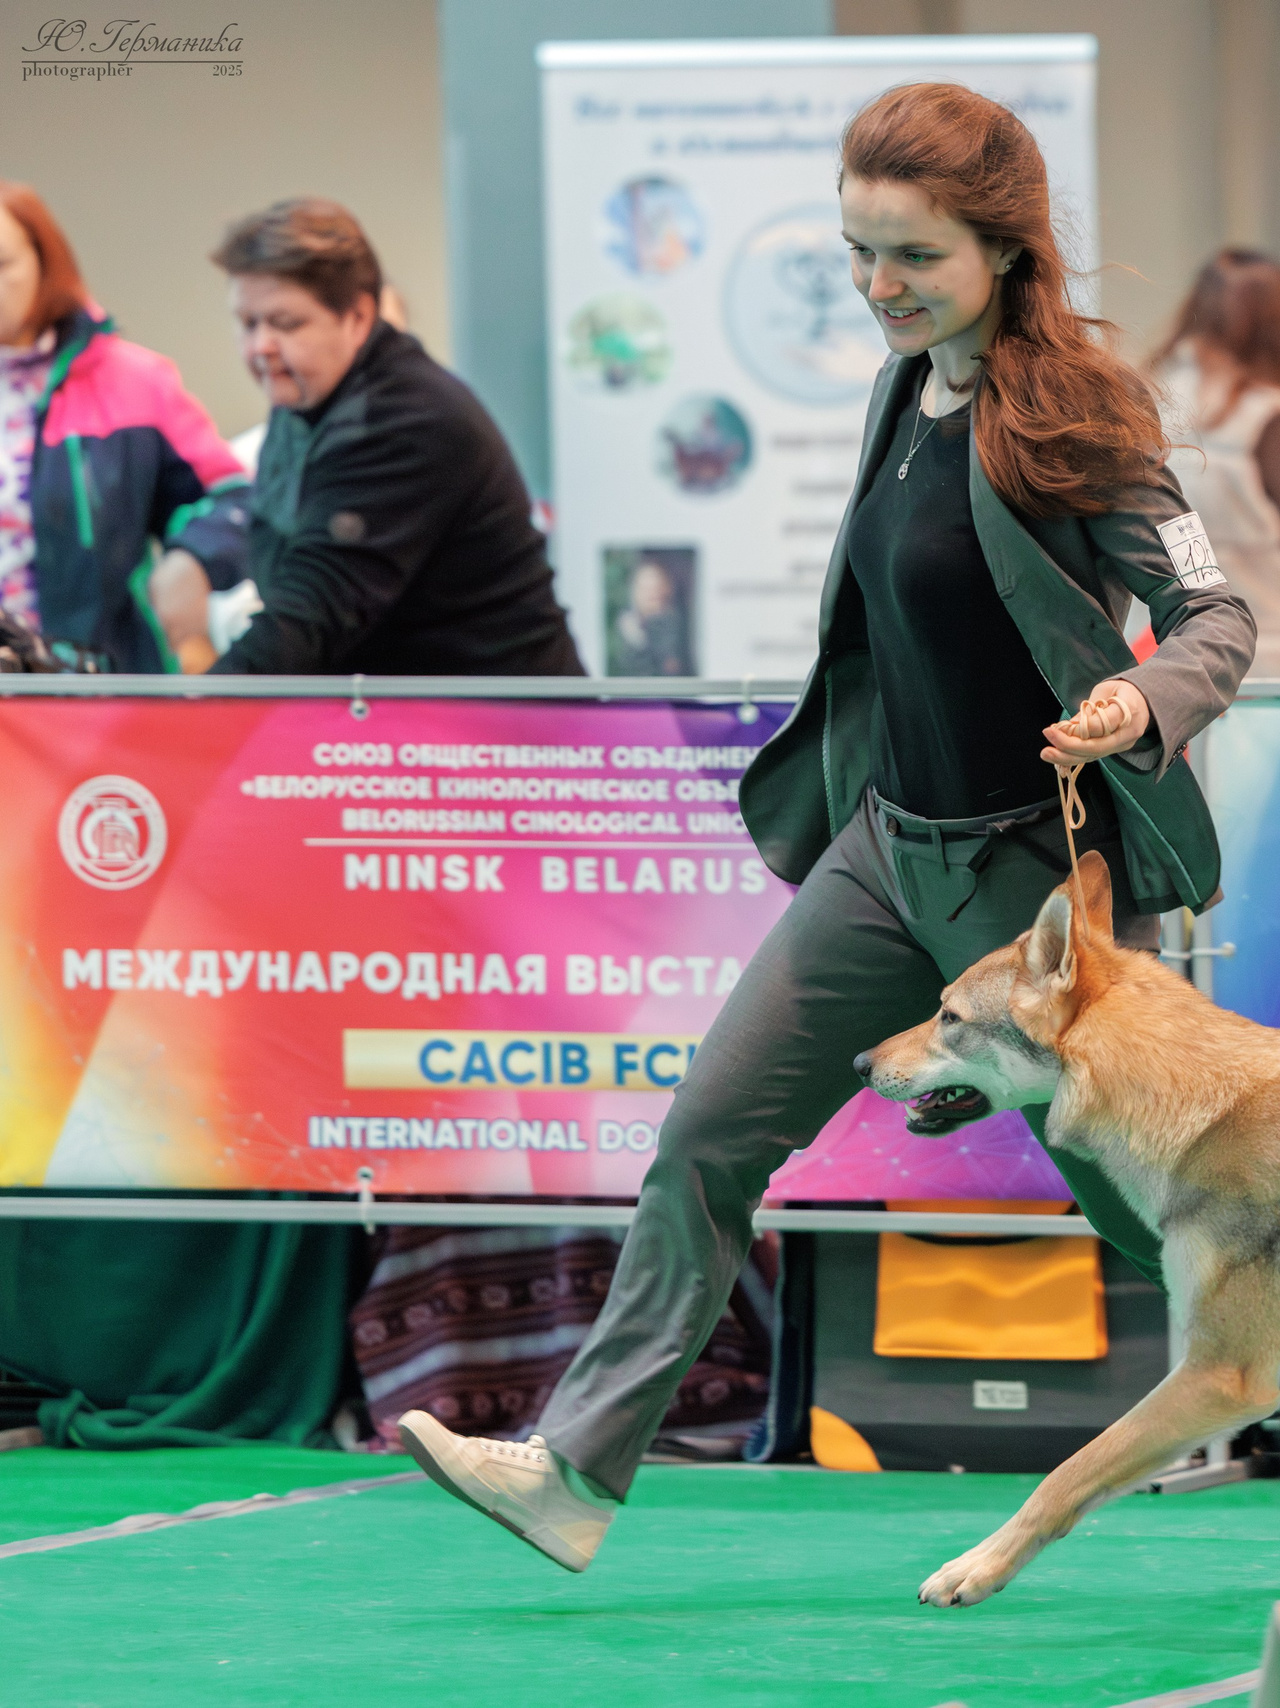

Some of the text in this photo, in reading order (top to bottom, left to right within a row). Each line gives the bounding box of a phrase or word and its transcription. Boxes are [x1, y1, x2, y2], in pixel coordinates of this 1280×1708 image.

[313, 743, 394, 767] СОЮЗ
[398, 743, 605, 770] ОБЩЕСТВЕННЫХ
[437, 776, 670, 801] КИНОЛОГИЧЕСКОЕ
[341, 807, 506, 833] BELORUSSIAN
[510, 810, 682, 834] CINOLOGICAL
[343, 853, 768, 895] MINSK BELARUS
[62, 948, 548, 1000] МЕЖДУНАРОДНАЯ
[418, 1039, 591, 1086] CACIB
[308, 1116, 661, 1155] INTERNATIONAL DO
